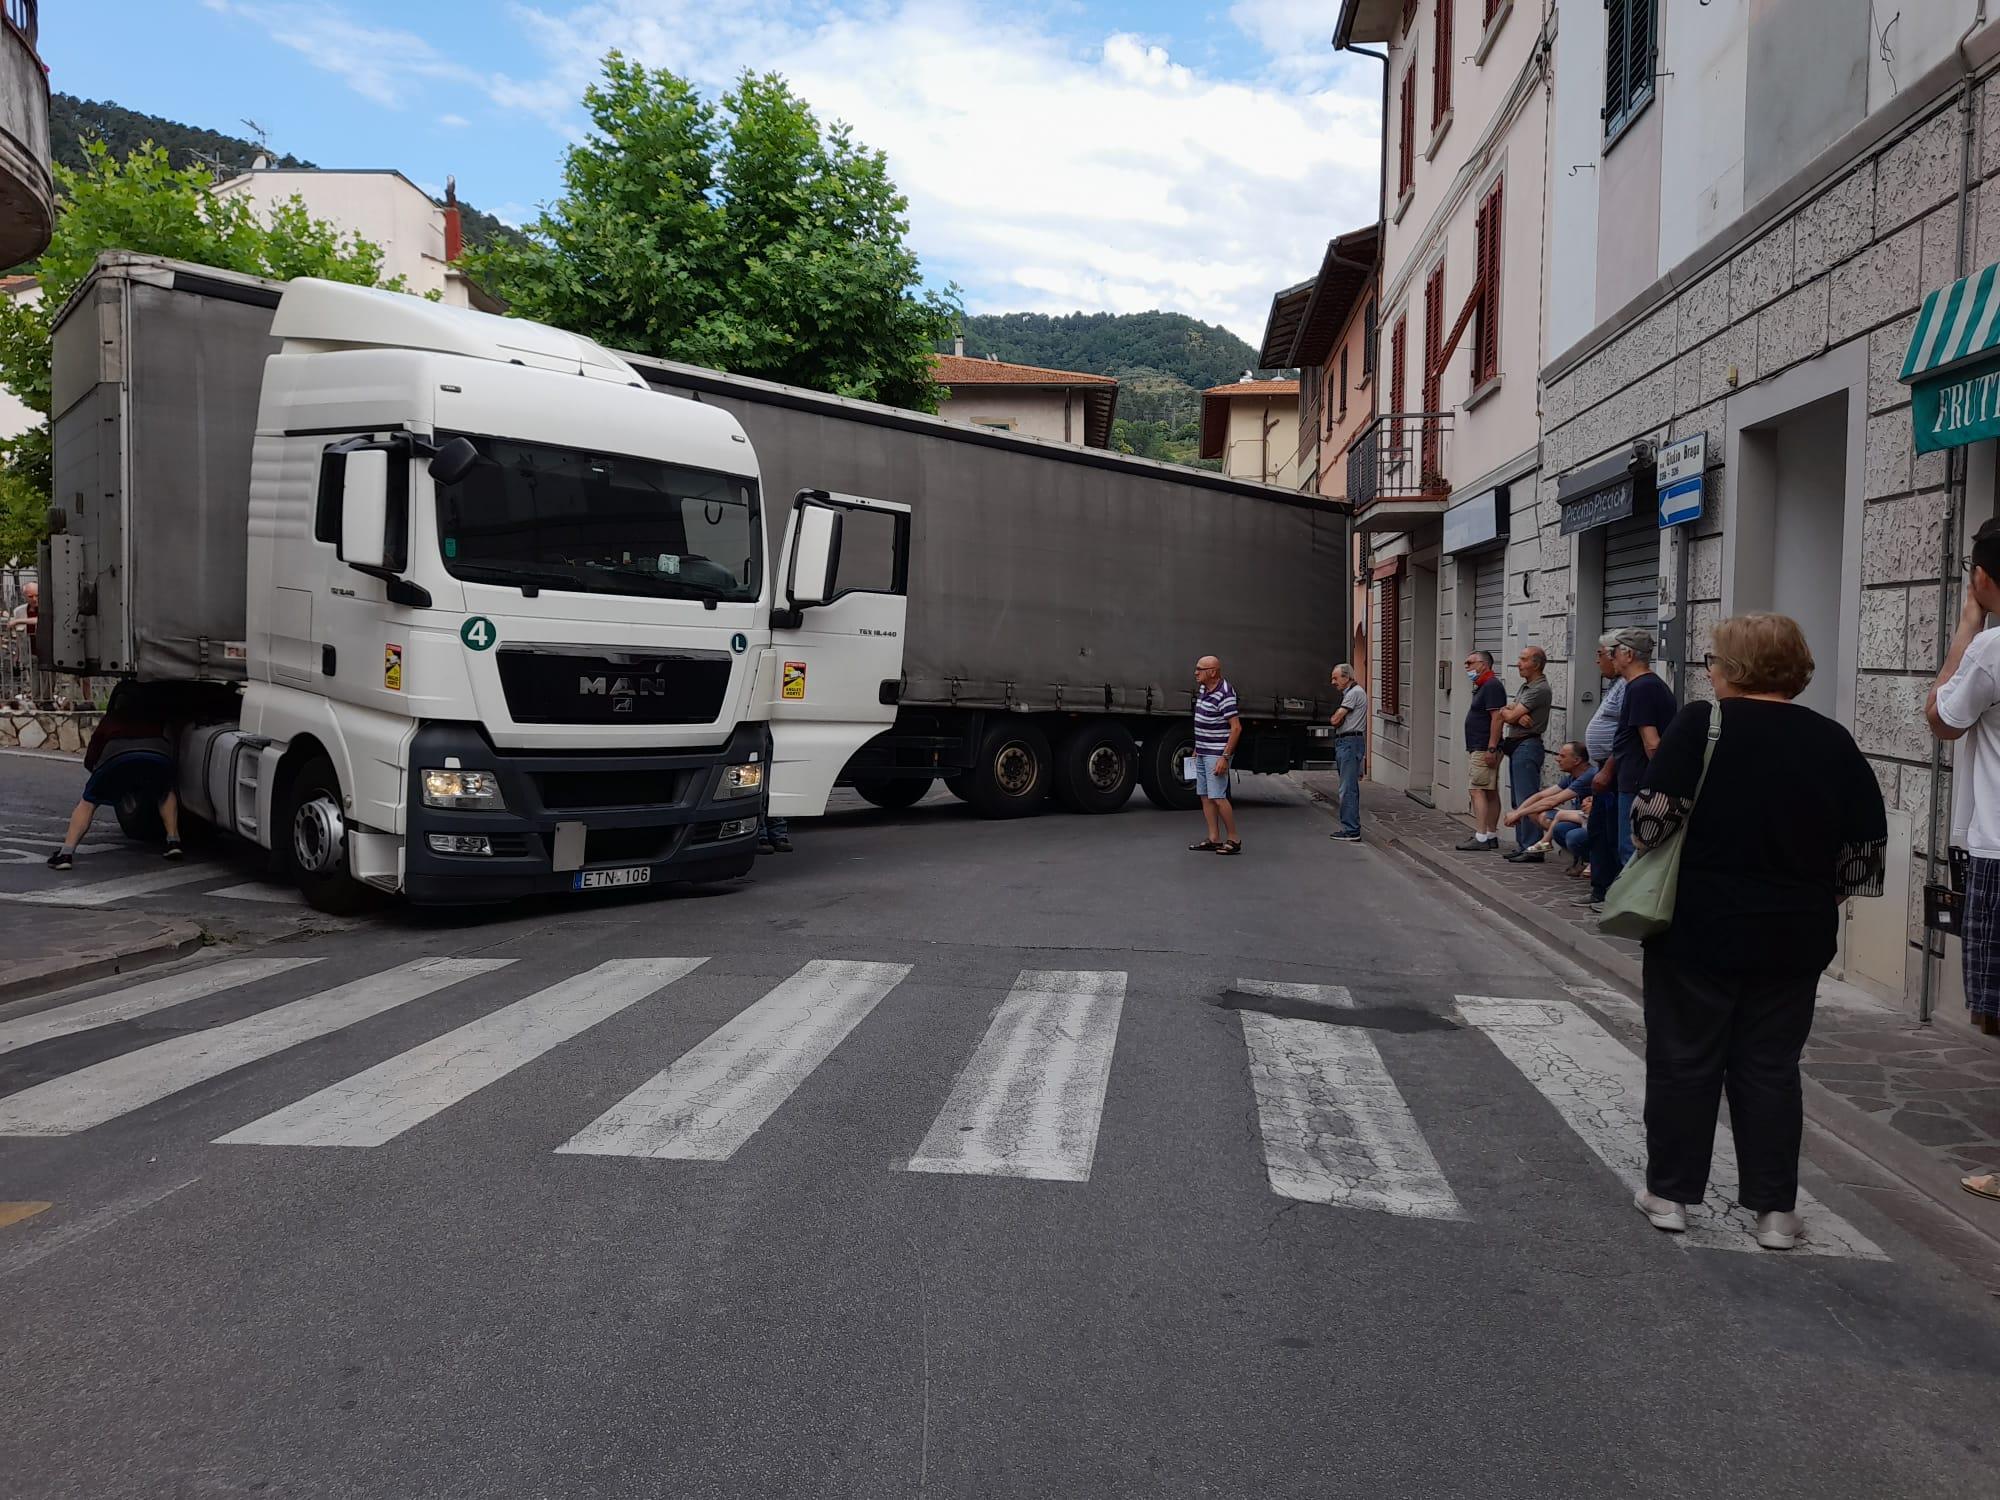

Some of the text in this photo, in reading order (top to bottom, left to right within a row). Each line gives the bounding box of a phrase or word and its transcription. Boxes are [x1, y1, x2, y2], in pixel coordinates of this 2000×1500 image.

[1683, 444, 1700, 460] Braga
[467, 620, 488, 646] 4
[735, 636, 744, 650] L
[579, 676, 665, 696] MAN
[583, 871, 615, 887] ETN
[625, 868, 648, 883] 106
